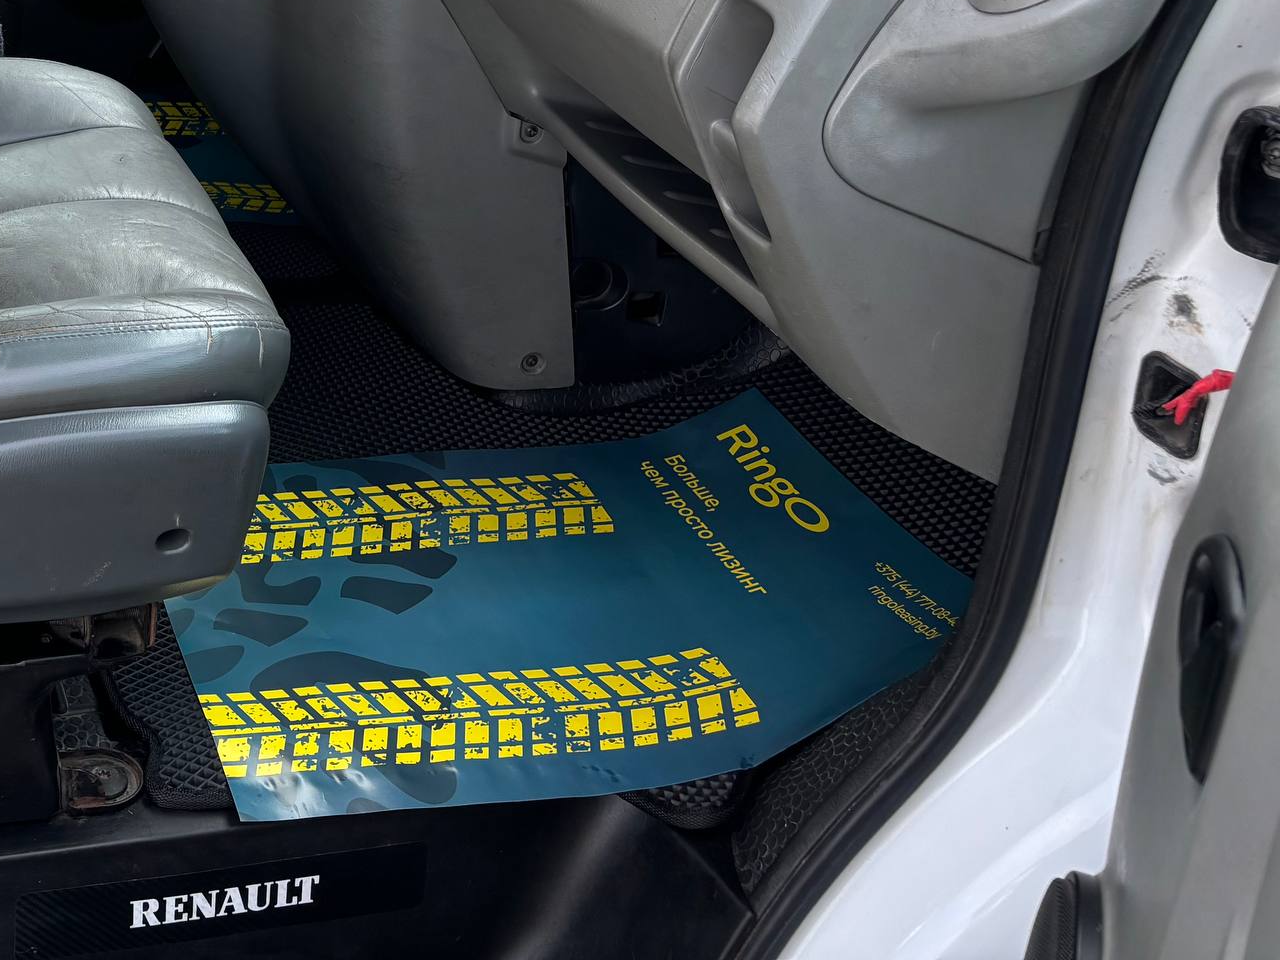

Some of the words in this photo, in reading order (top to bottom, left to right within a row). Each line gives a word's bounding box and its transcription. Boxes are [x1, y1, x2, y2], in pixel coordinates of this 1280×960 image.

[664, 454, 720, 512] Больше,
[716, 424, 830, 533] Ringo
[641, 461, 670, 488] чем
[662, 490, 713, 539] просто
[706, 542, 767, 594] лизинг
[868, 585, 942, 640] ringoleasing.by
[875, 562, 902, 582] +375
[892, 580, 920, 599] (44)
[915, 595, 959, 627] 771-08-4
[129, 874, 320, 929] RENAULT
